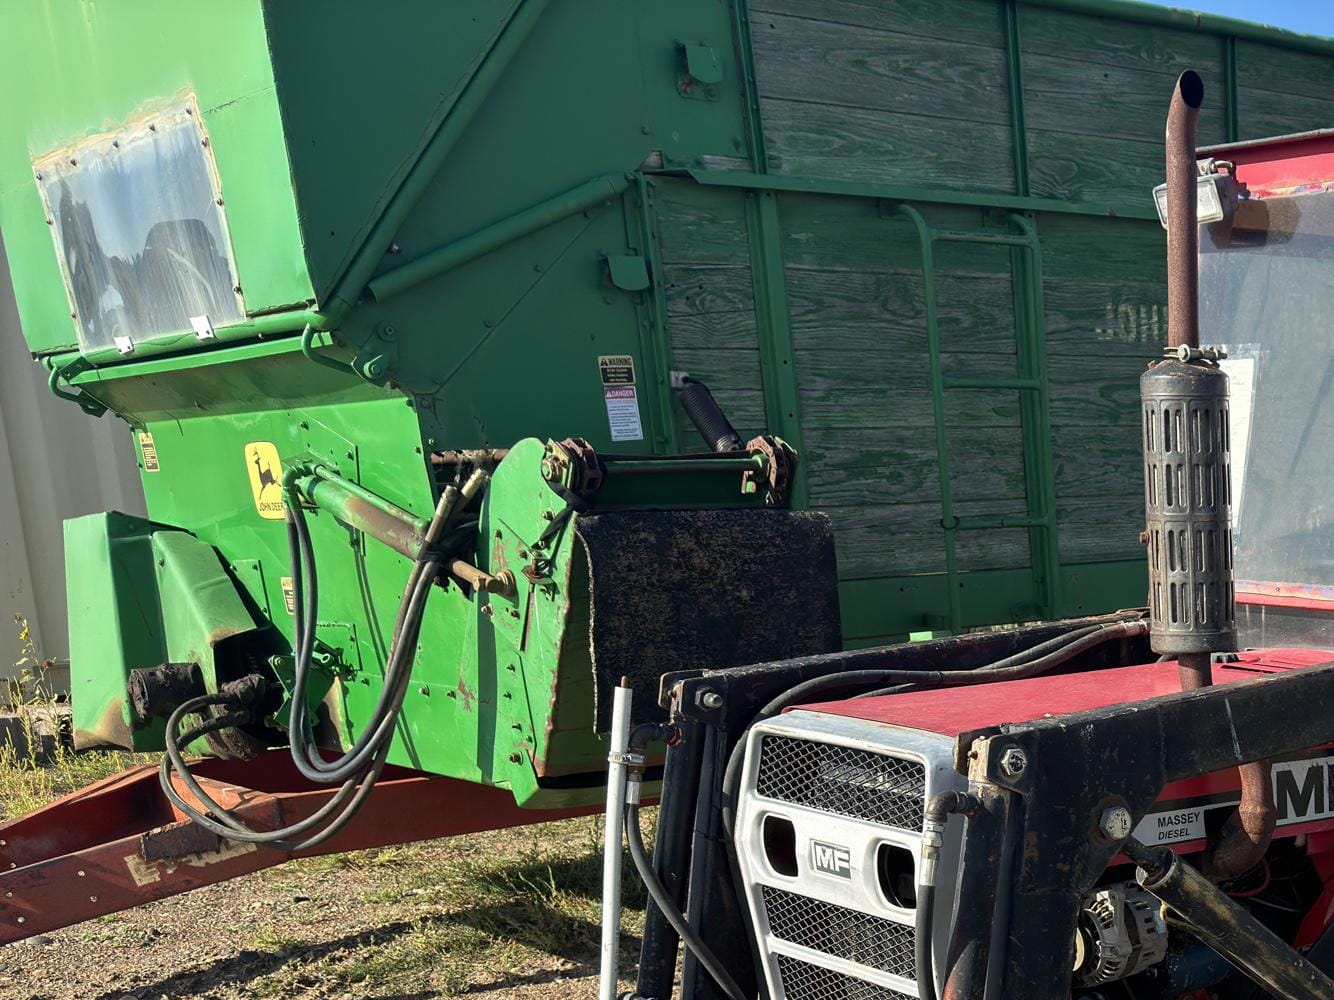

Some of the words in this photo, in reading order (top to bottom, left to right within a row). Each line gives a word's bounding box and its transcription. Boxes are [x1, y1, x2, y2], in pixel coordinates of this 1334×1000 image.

[611, 389, 634, 397] DANGER
[259, 501, 272, 512] JOHN
[271, 501, 285, 512] DEER
[1157, 811, 1201, 828] MASSEY
[1158, 828, 1191, 841] DIESEL
[815, 844, 850, 872] MF
